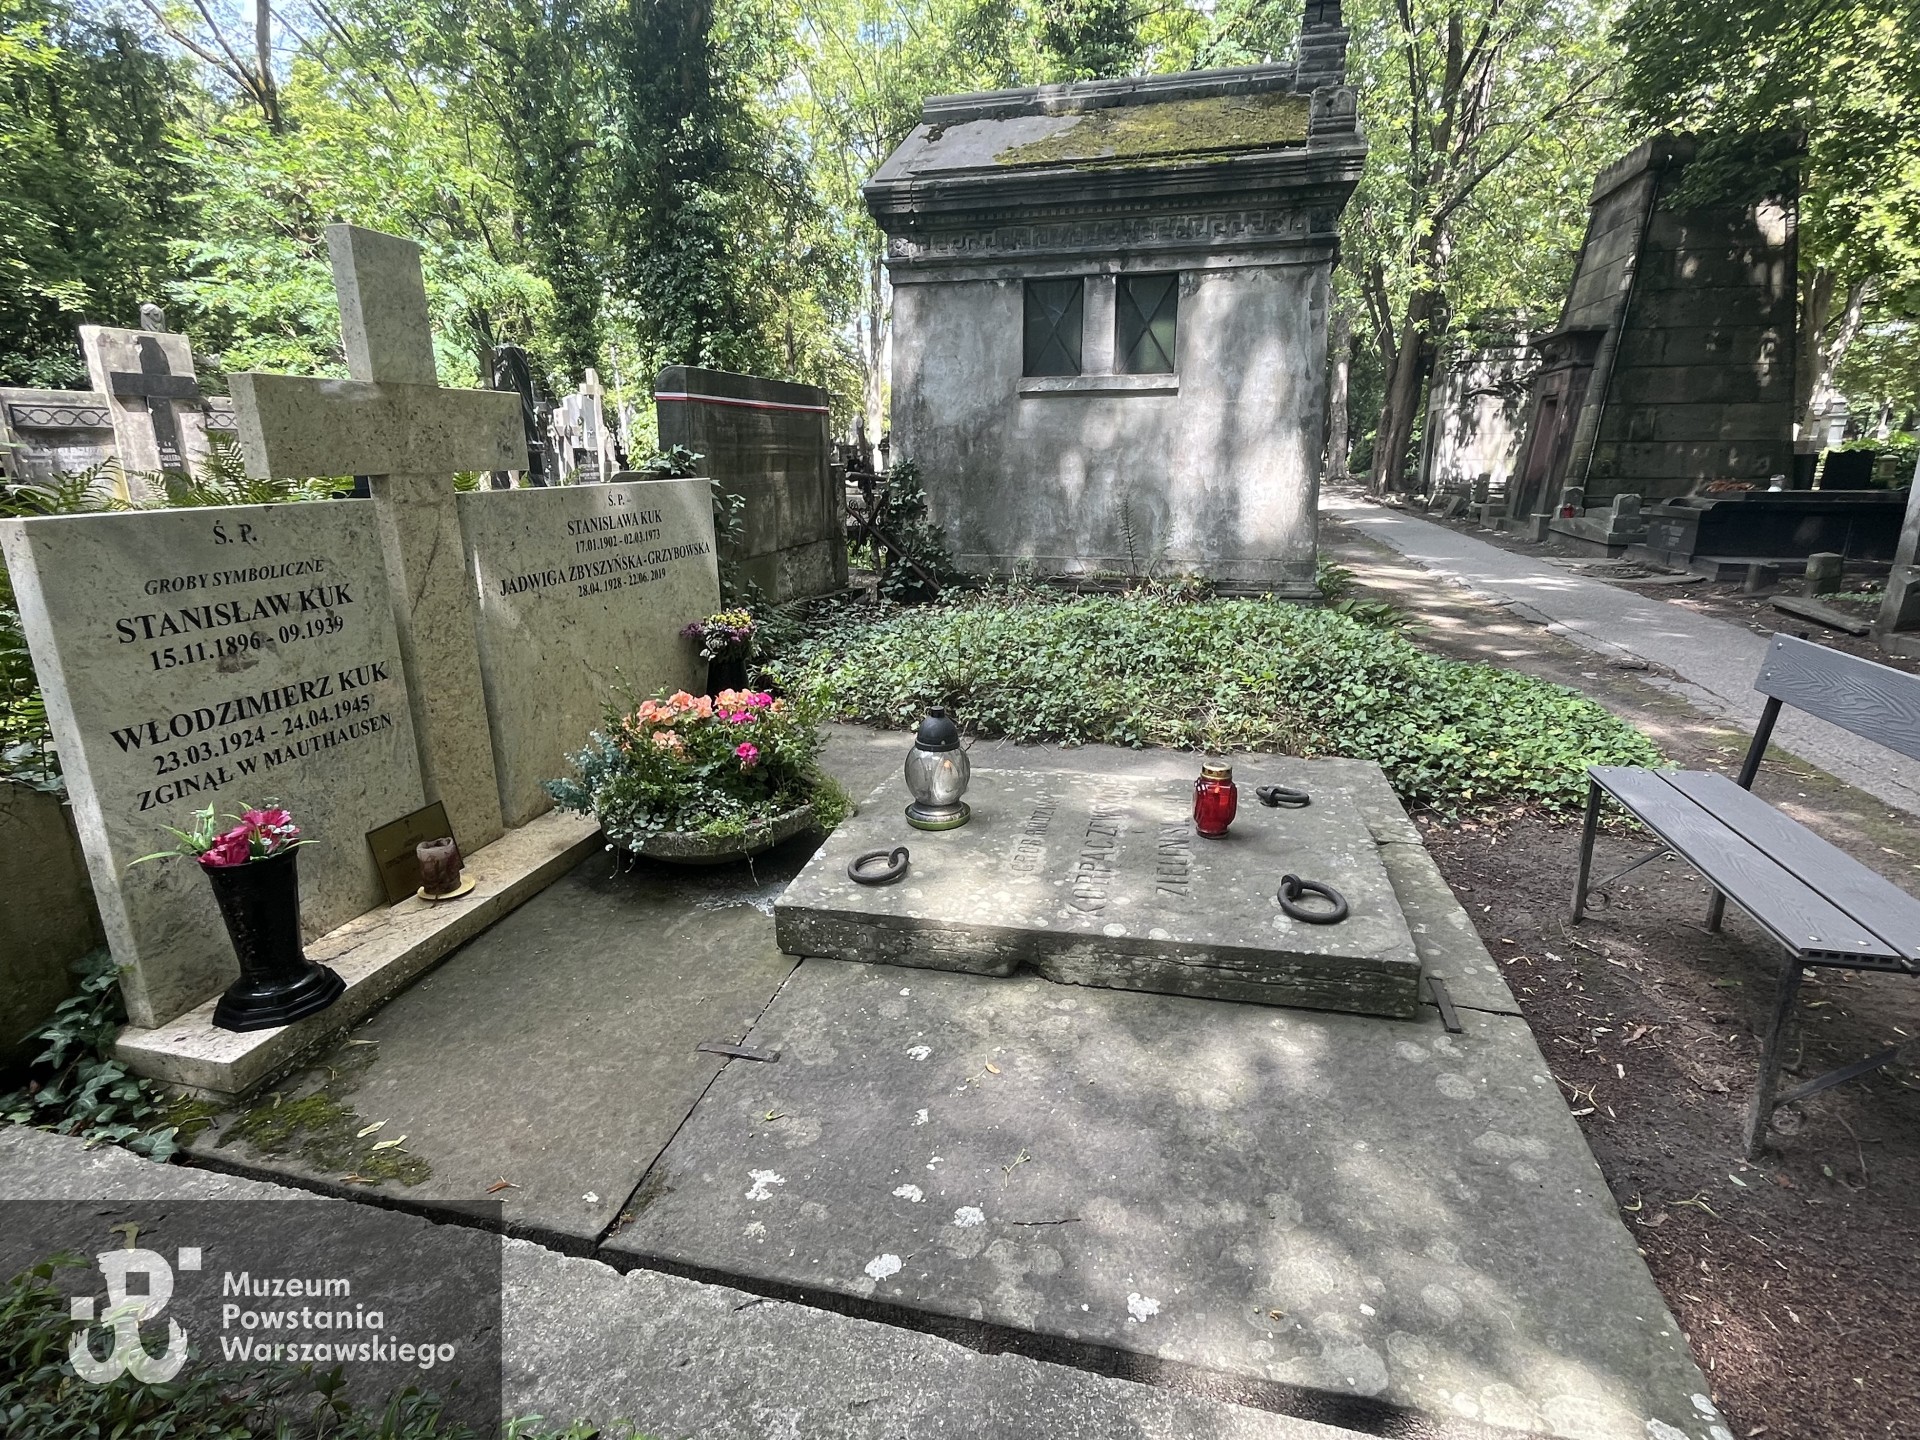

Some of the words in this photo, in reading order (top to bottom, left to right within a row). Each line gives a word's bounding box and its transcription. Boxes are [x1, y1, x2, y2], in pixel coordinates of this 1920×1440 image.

[212, 520, 234, 545] Ś.
[239, 523, 258, 544] P.
[576, 535, 617, 554] 17.01.1902
[624, 529, 661, 545] 02.03.1973
[640, 509, 662, 525] KUK
[144, 573, 209, 597] GROBY
[212, 559, 325, 587] SYMBOLICZNE
[500, 568, 567, 597] JADWIGA
[568, 541, 711, 582] ZBYSZYŃSKA-GRZYBOWSKA
[604, 577, 622, 592] 1928
[651, 568, 666, 581] 2019
[115, 592, 291, 645] STANISŁAW
[298, 583, 353, 612] KUK
[149, 630, 261, 671] 15.11.1896
[278, 616, 344, 644] 09.1939
[110, 676, 334, 753] WŁODZIMIERZ
[338, 660, 389, 692] KUK
[137, 765, 234, 811] ZGINĄŁ
[237, 755, 258, 777] W
[264, 712, 393, 769] MAUTHAUSEN
[153, 726, 266, 776] 23.03.1924
[283, 694, 370, 737] 24.04.1945
